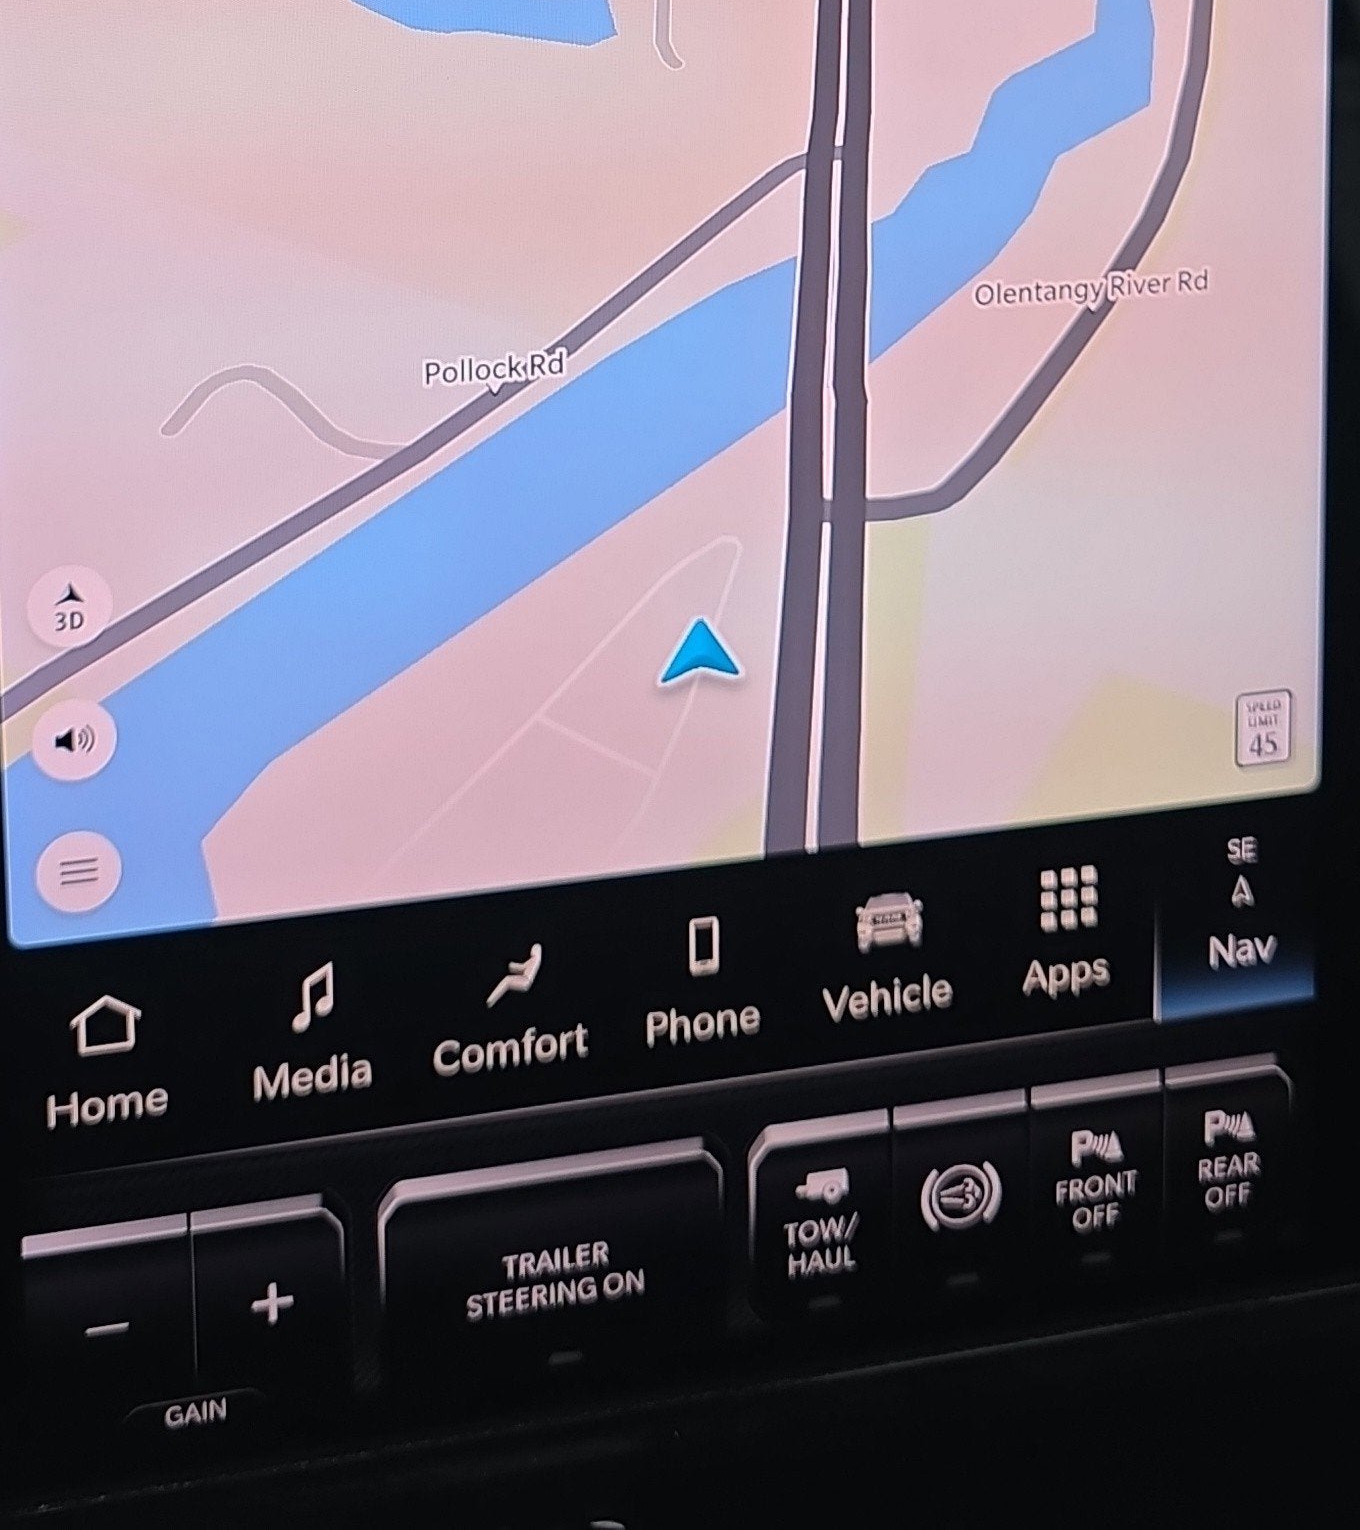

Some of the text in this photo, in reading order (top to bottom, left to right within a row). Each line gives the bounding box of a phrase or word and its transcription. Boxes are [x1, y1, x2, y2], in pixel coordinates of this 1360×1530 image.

[974, 268, 1210, 308] Olentangy River Rd
[424, 350, 565, 386] Pollock Rd
[55, 611, 84, 632] 3D
[1246, 699, 1282, 713] SPEED
[1248, 714, 1278, 728] LIMIT
[1249, 731, 1278, 757] 45
[1227, 835, 1258, 864] SE
[1208, 932, 1278, 971] Nav
[1023, 954, 1110, 1000] Apps
[822, 972, 953, 1024] Vehicle
[646, 1003, 761, 1049] Phone
[433, 1021, 589, 1077] Comfort
[253, 1052, 372, 1102] Media
[46, 1083, 168, 1130] Home
[1198, 1150, 1261, 1184] REAR
[1056, 1169, 1138, 1207] FRONT
[1205, 1181, 1252, 1214] OFF
[783, 1210, 859, 1250] TOW/
[1072, 1201, 1120, 1233] OFF
[502, 1239, 609, 1280] TRAILER
[788, 1245, 856, 1280] HAUL
[466, 1268, 644, 1322] STEERING ON
[164, 1396, 227, 1428] GAIN
